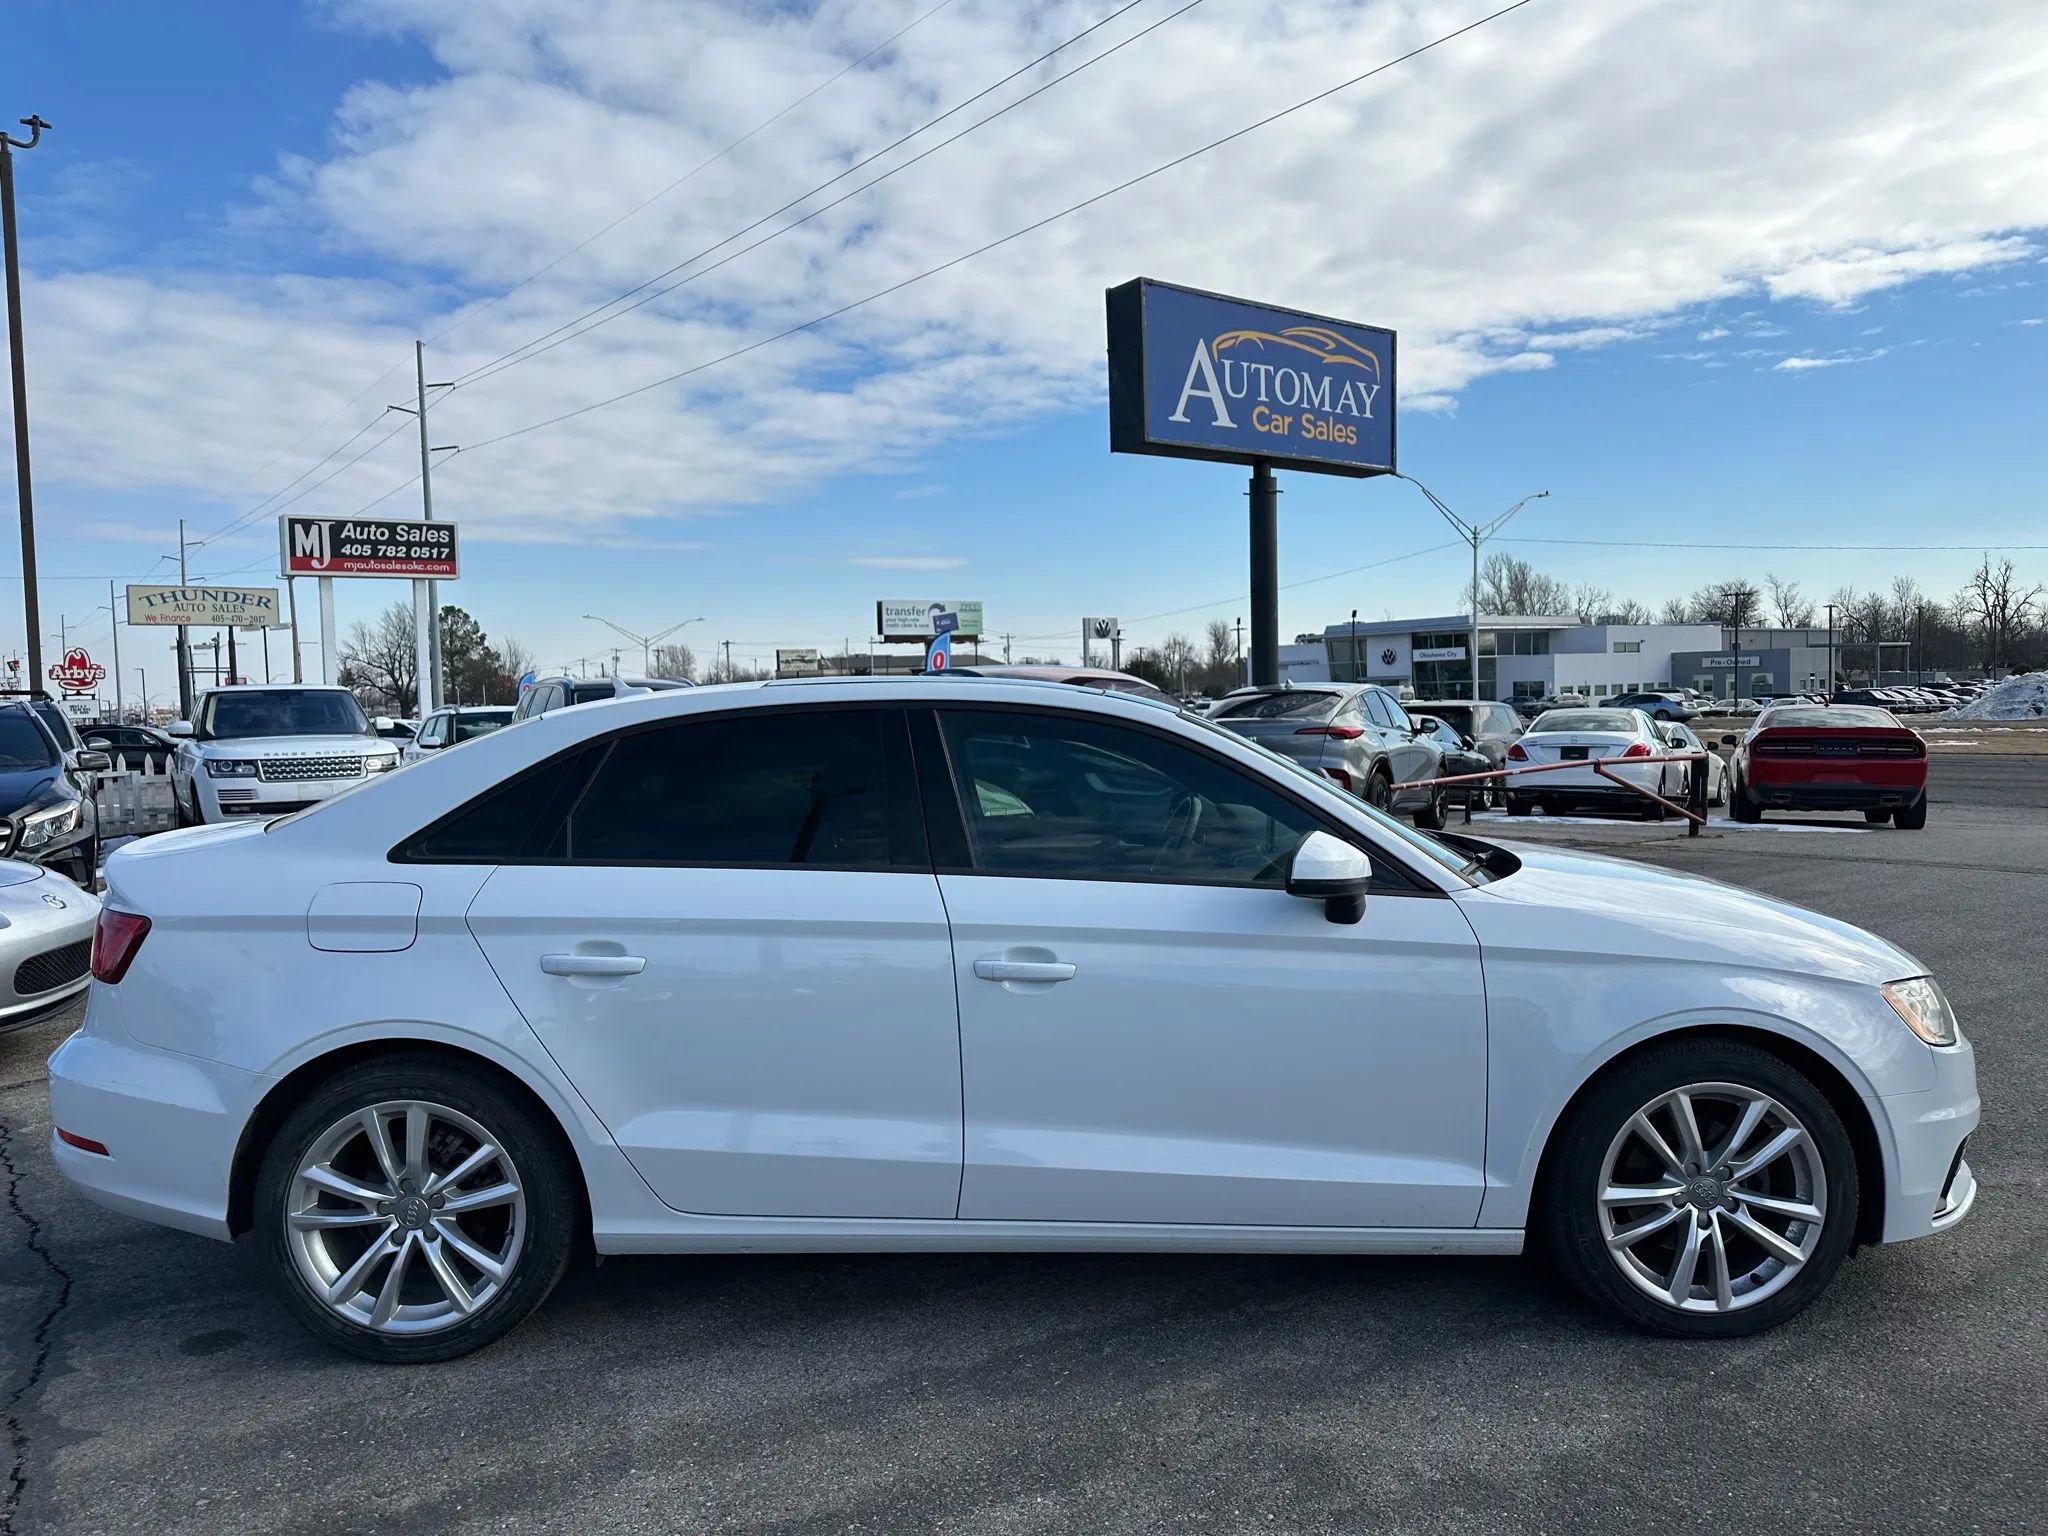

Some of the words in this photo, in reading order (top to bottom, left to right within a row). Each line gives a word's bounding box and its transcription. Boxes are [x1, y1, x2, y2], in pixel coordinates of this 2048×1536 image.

[1168, 338, 1380, 428] AUTOMAY
[1252, 405, 1292, 435] Car
[1301, 413, 1357, 446] Sales
[340, 522, 390, 541] Auto
[395, 525, 450, 543] Sales
[294, 521, 335, 569] MJ
[341, 543, 372, 556] 405
[377, 545, 407, 558] 782
[410, 547, 450, 559] 0517
[344, 559, 450, 572] mjautosalesokc.com
[138, 589, 272, 610] THUNDER
[174, 602, 206, 613] AUTO
[212, 602, 246, 614] SALES
[885, 606, 926, 617] transfer
[144, 613, 157, 623] We
[160, 613, 192, 623] Finance
[211, 614, 266, 624] 405-470-2017
